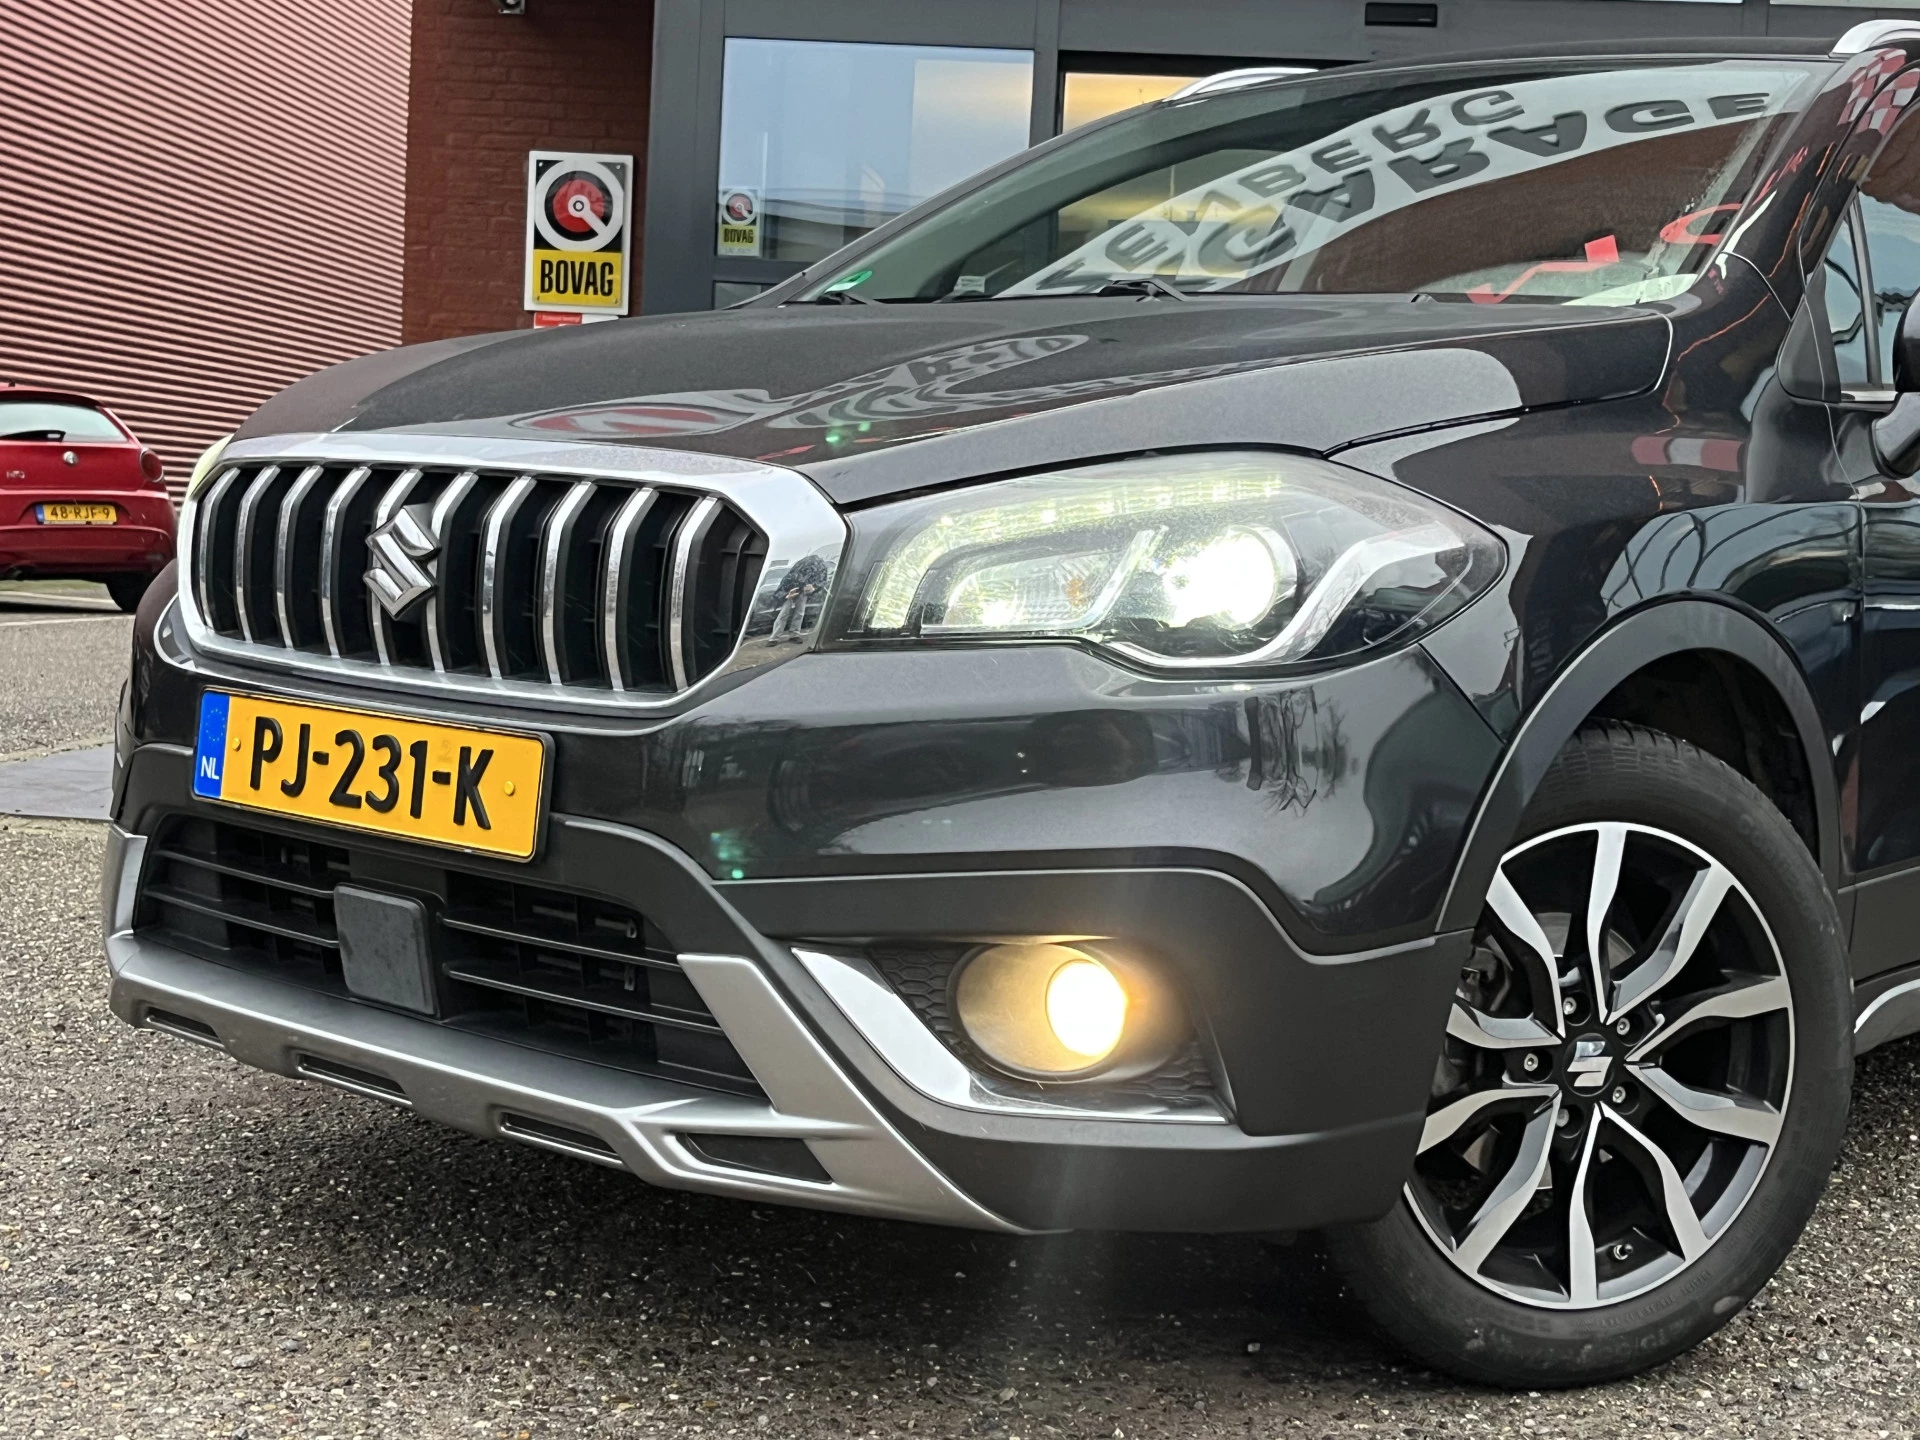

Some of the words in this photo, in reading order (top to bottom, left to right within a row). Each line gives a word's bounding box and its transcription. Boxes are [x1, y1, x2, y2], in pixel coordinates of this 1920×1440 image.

[723, 228, 754, 244] BOVAG
[540, 259, 614, 297] BOVAG
[50, 505, 111, 520] 48-RJF-9
[200, 755, 220, 780] NL
[249, 716, 494, 831] PJ-231-K
